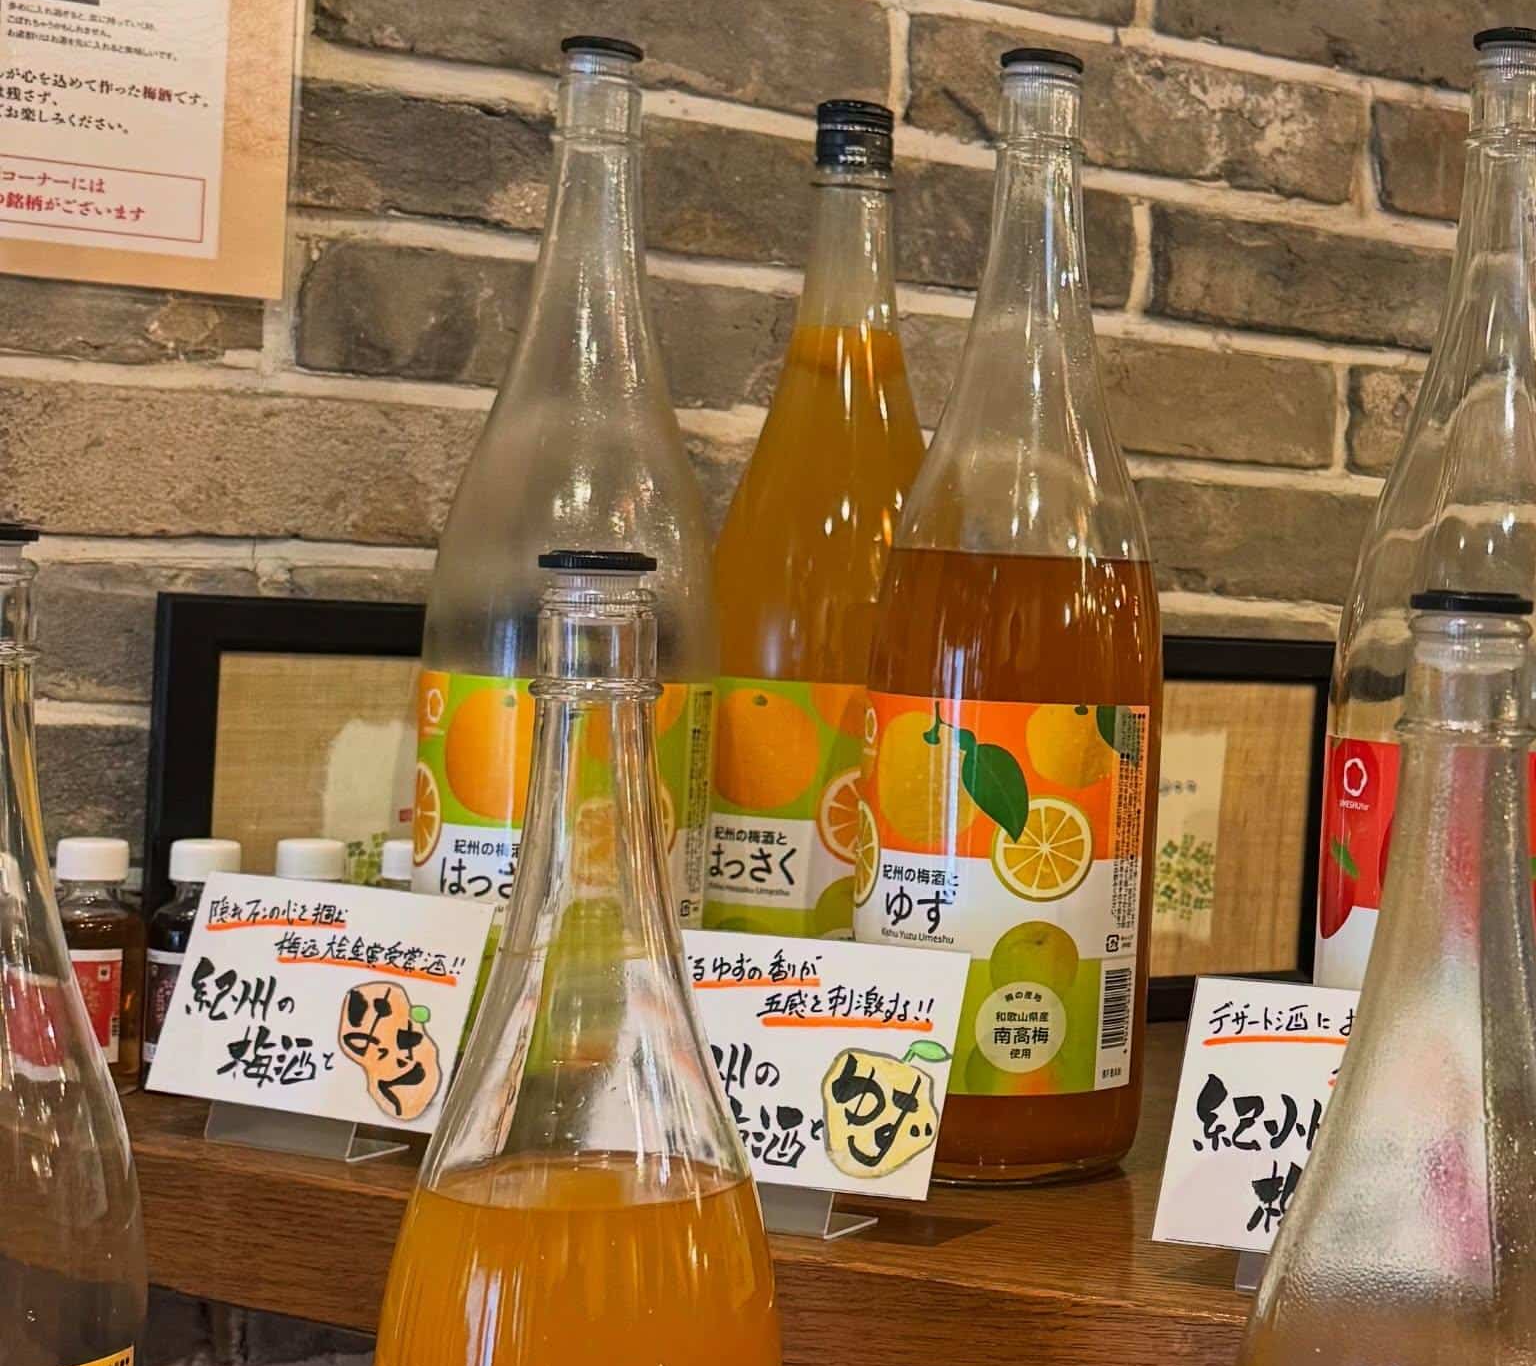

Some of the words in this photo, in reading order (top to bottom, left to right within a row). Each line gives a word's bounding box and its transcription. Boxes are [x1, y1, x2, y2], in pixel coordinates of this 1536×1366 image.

[714, 826, 788, 846] 紀州の梅酒と
[885, 886, 958, 934] ゆず
[918, 931, 955, 945] Umeshu
[185, 956, 295, 1021] 紀州の
[995, 1011, 1049, 1023] 和歌山県産
[993, 1026, 1050, 1045] 南高梅
[1009, 1048, 1032, 1060] 使用
